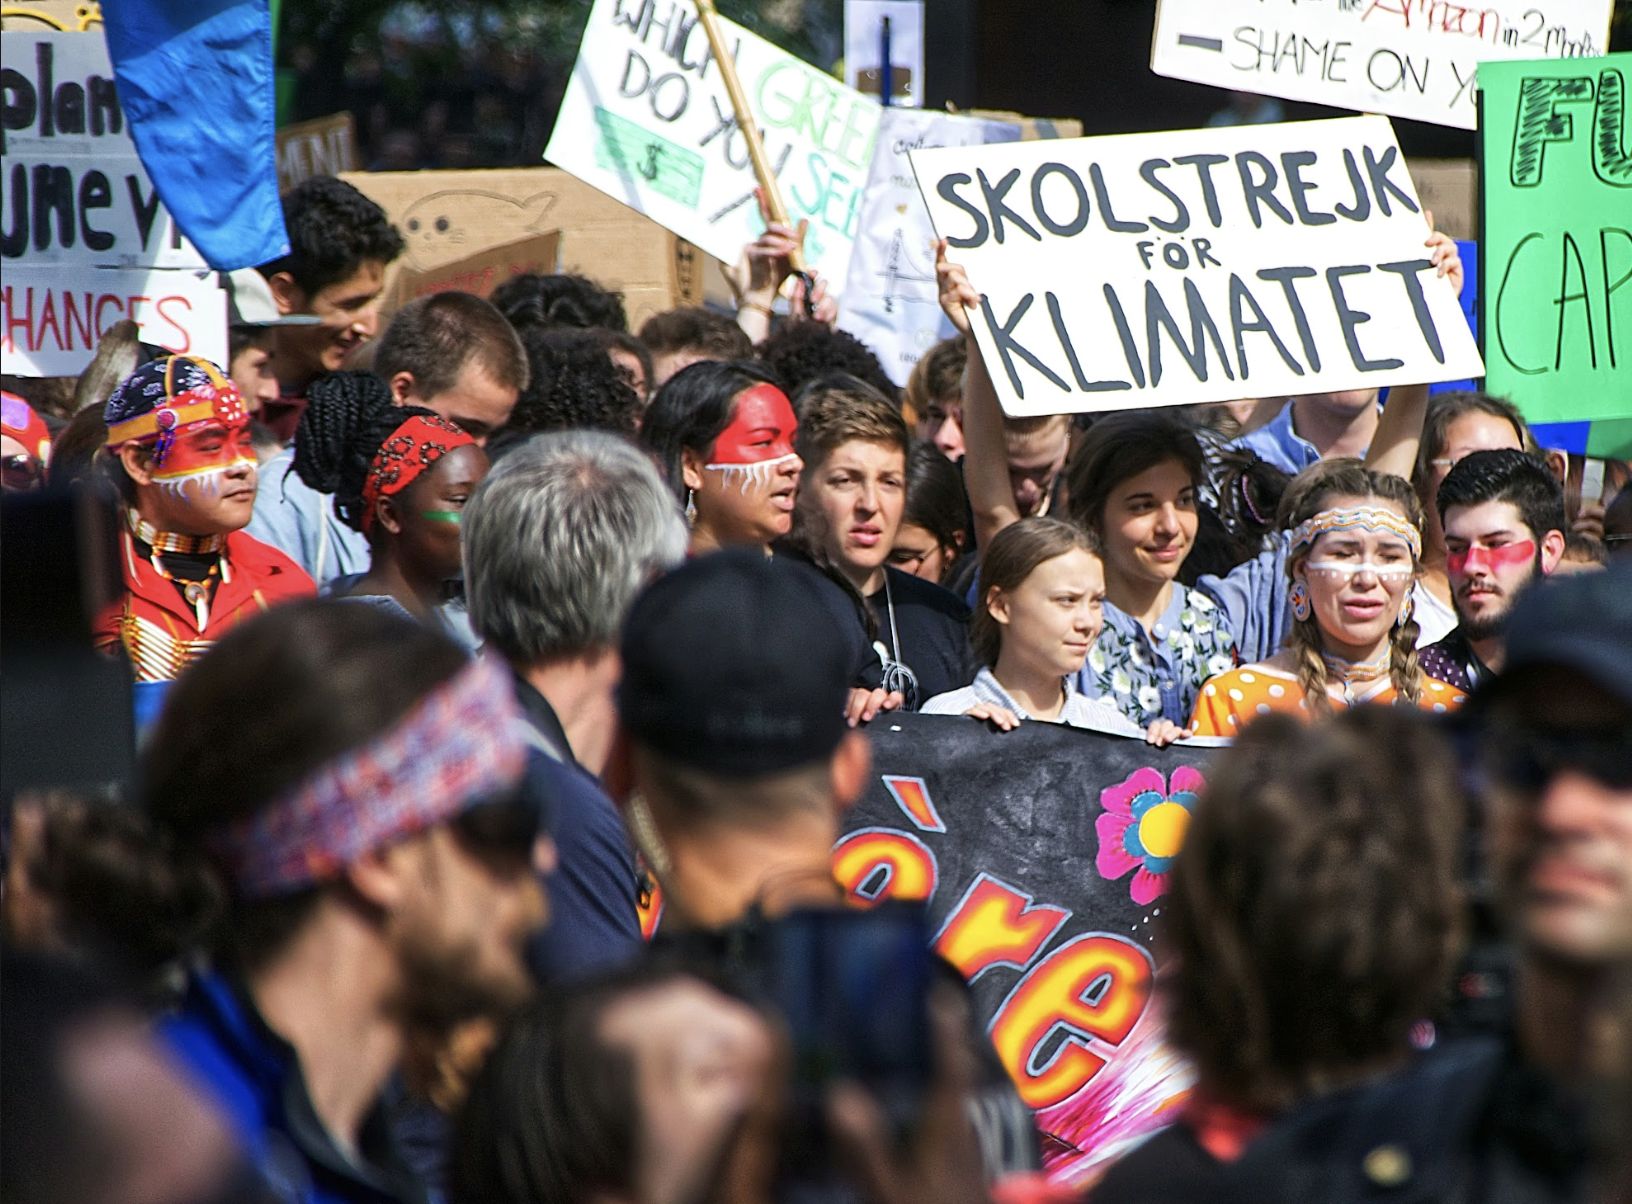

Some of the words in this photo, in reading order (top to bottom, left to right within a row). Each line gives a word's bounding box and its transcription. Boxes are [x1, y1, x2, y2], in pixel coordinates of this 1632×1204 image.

[1503, 17, 1519, 48] in
[1520, 8, 1546, 48] 2
[618, 49, 690, 122] DO
[1230, 26, 1353, 82] SHAME
[1367, 48, 1429, 94] ON
[1449, 60, 1478, 109] Y
[936, 144, 1420, 249] SKOLSTREJK
[1136, 235, 1222, 270] FÖR
[977, 258, 1445, 400] KLIMATET
